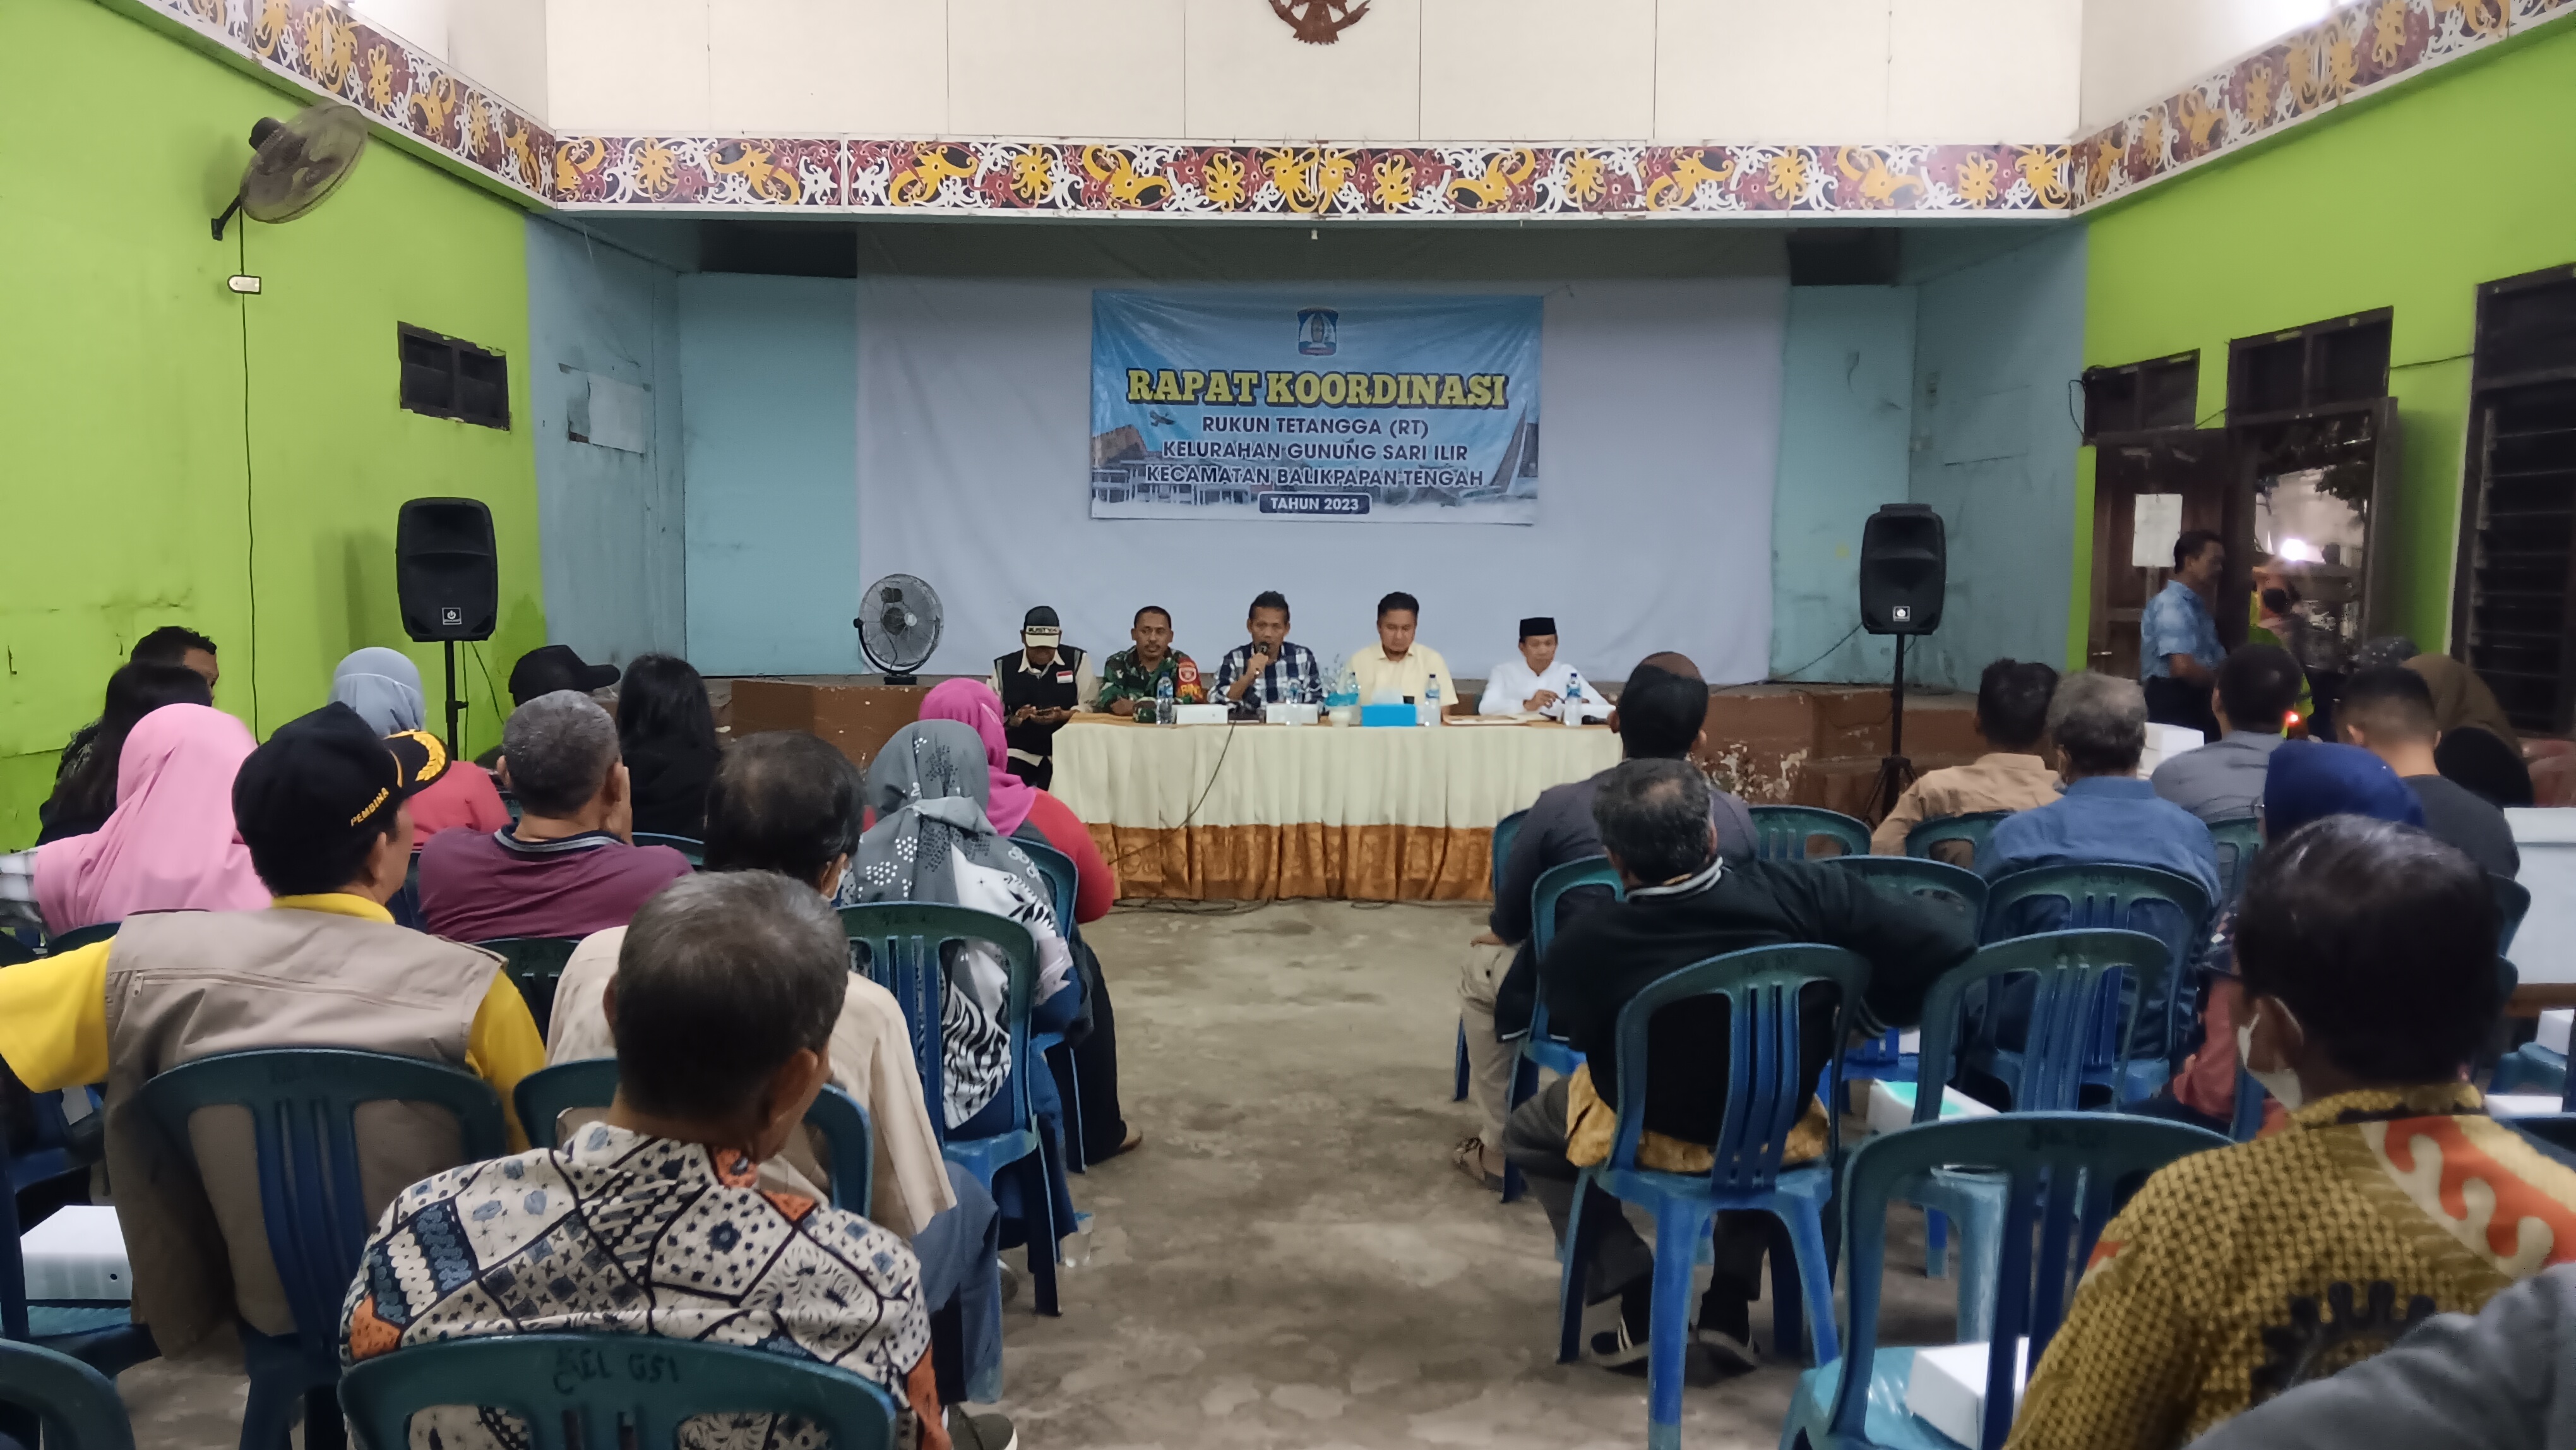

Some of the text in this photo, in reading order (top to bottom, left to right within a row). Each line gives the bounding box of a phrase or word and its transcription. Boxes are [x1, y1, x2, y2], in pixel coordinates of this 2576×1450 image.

[1127, 368, 1508, 409] RAPAT KOORDINASI
[1202, 416, 1429, 440] RUKUN TETANGGA (RT)
[1163, 441, 1468, 460] KELURAHAN GUNUNG SARI ILIR
[1147, 465, 1483, 486] KECAMATAN BALIKPAPAN TENGAH
[1270, 497, 1359, 511] TAHUN 2023
[350, 787, 390, 828] PEMBINA
